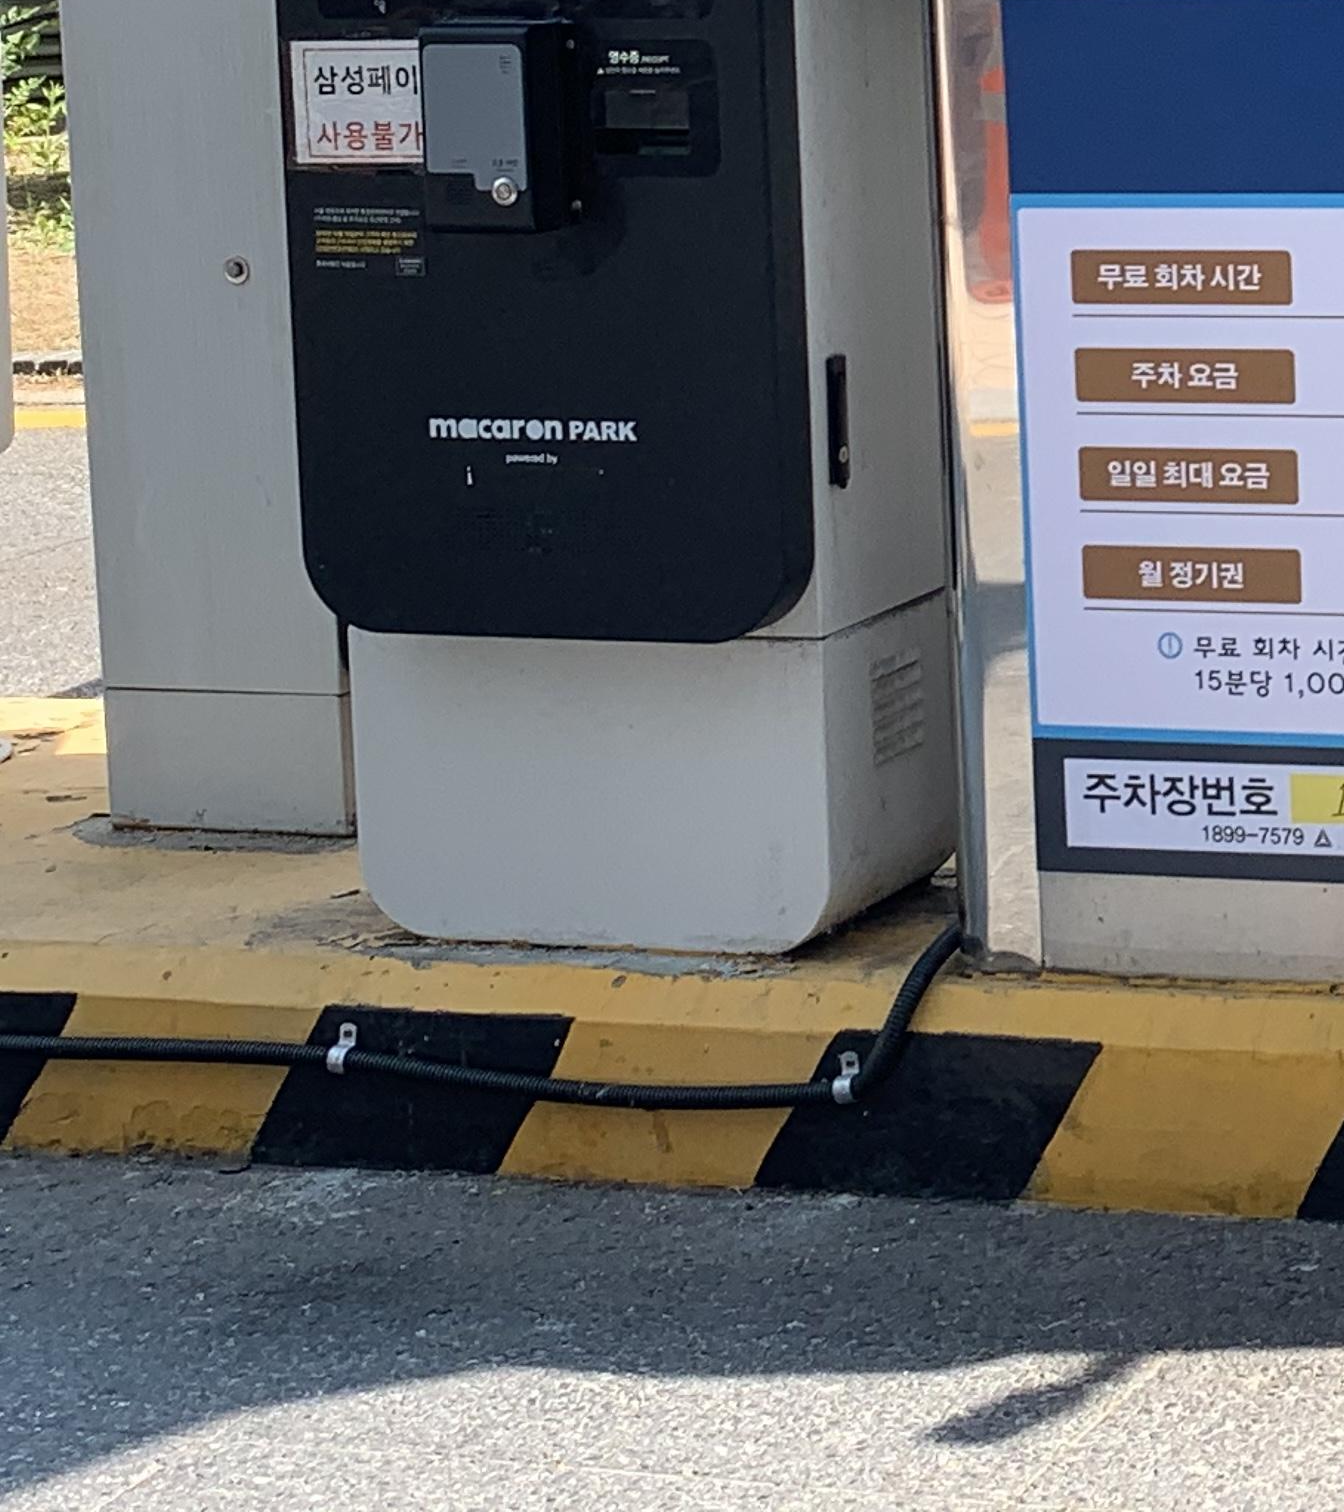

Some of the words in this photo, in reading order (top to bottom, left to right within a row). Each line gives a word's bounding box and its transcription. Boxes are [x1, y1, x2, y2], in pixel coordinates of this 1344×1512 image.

[608, 50, 639, 65] 영수증
[314, 65, 417, 95] 삼성페이
[317, 121, 423, 152] 사용불가
[1098, 265, 1149, 290] 무료
[1155, 264, 1205, 290] 회차
[1210, 264, 1261, 290] 시간
[1132, 362, 1182, 388] 주차
[1188, 363, 1238, 389] 요금
[430, 418, 562, 440] macaron
[569, 421, 637, 441] PARK
[1108, 461, 1156, 487] 일일
[1163, 462, 1213, 488] 최대
[1219, 463, 1269, 489] 요금
[1139, 561, 1162, 587] 월
[1170, 562, 1243, 588] 정기권
[1194, 637, 1241, 658] 무료
[1253, 637, 1300, 660] 회차
[1195, 670, 1272, 697] 15분당
[1083, 774, 1278, 816] 주차장번호
[1203, 825, 1304, 845] 1899-7579
